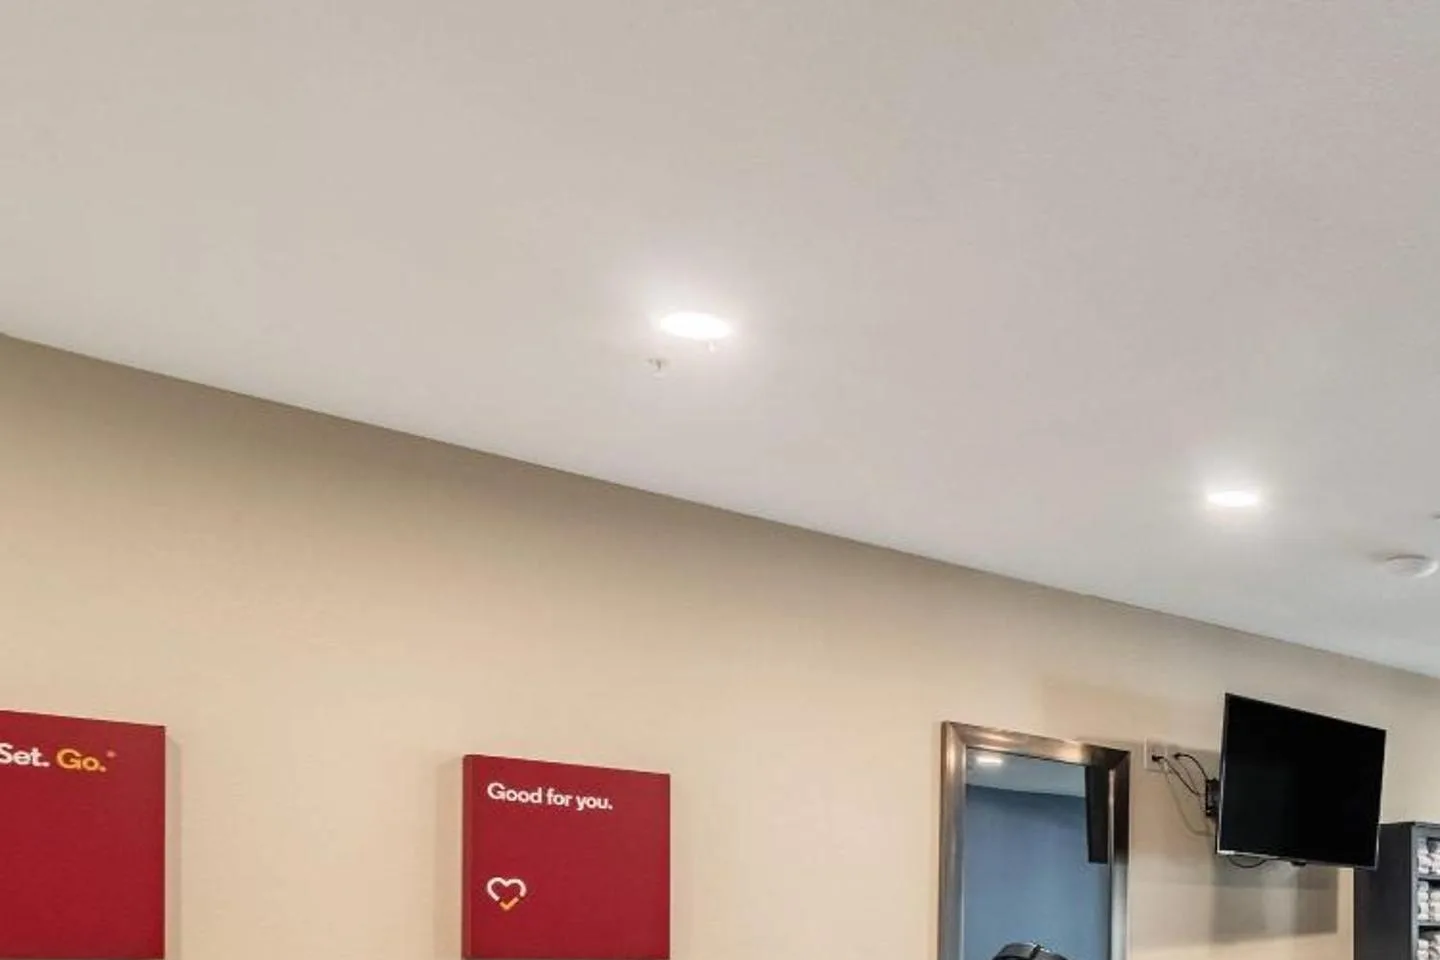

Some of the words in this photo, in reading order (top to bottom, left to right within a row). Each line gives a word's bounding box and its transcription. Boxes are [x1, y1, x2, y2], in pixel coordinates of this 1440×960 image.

[0, 742, 50, 767] Set.
[487, 782, 542, 804] Good
[546, 788, 573, 807] for
[575, 795, 613, 811] you.
